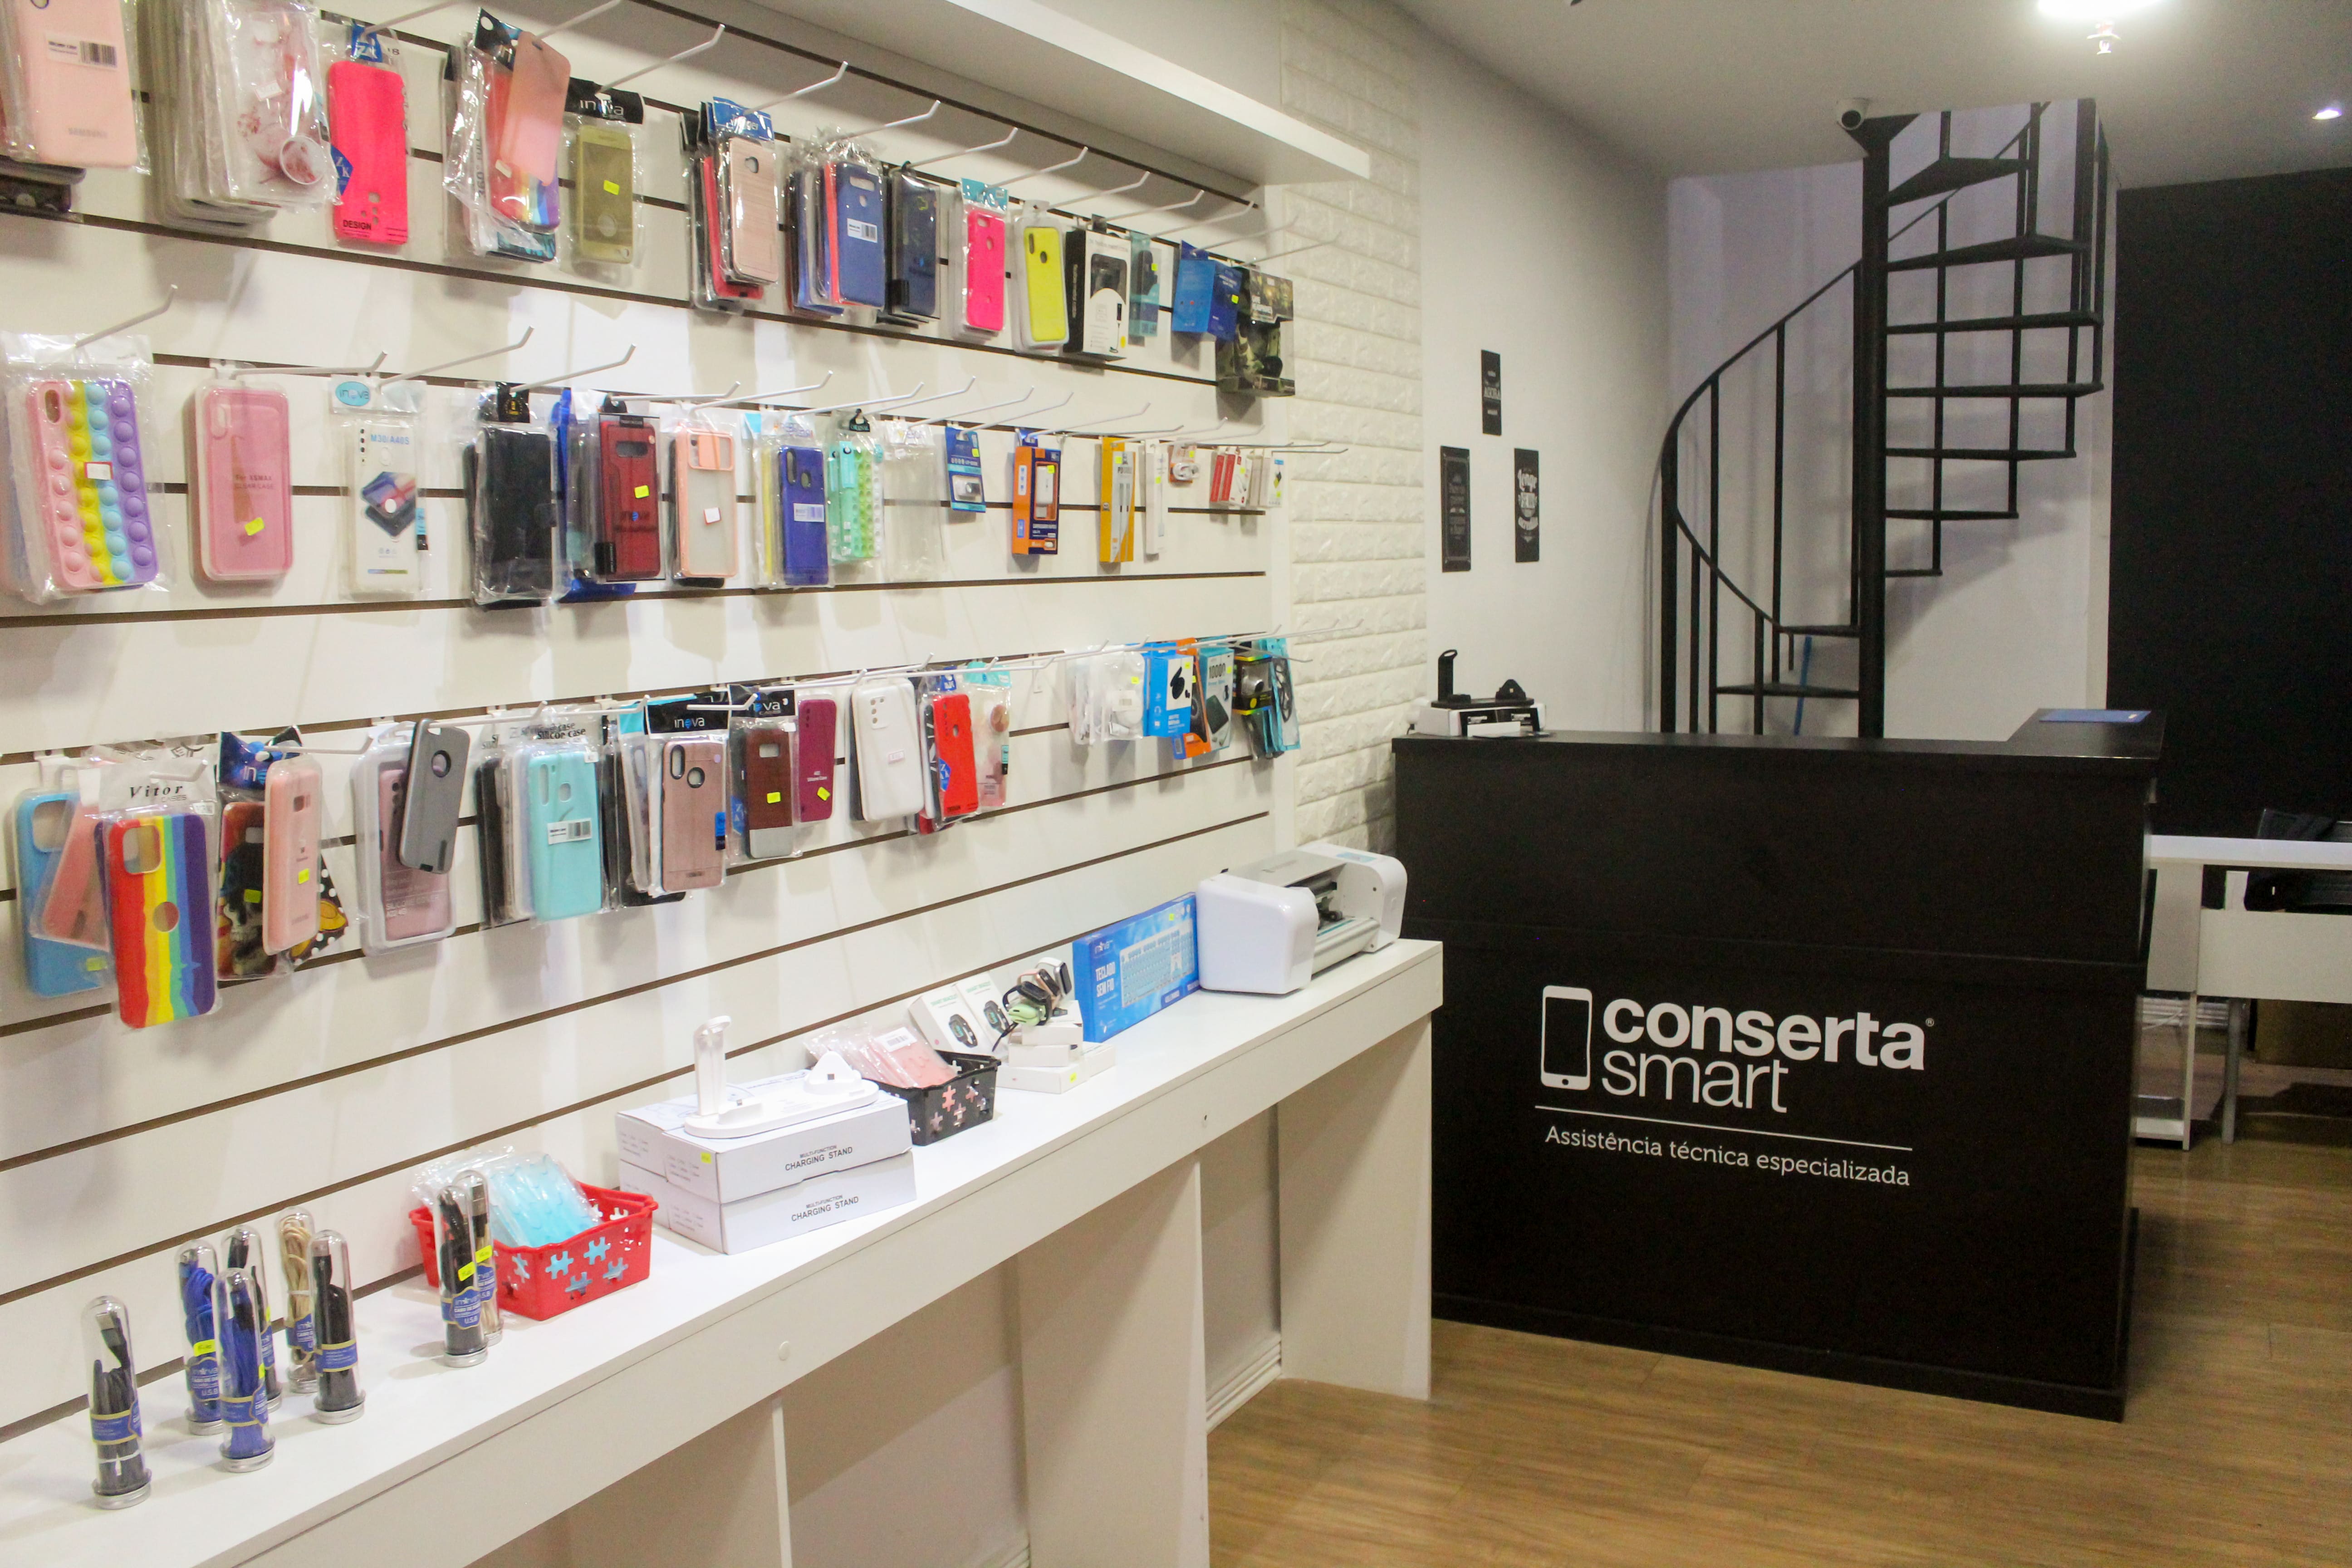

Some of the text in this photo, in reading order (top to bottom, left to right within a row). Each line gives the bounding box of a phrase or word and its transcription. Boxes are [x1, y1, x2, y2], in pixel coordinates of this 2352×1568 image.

[343, 220, 372, 230] DESIGN
[674, 717, 705, 729] inova
[130, 785, 182, 799] Vitor
[1603, 999, 1924, 1070] conserta
[1602, 1050, 1788, 1112] smart
[785, 1147, 853, 1171] CHARGING STAND
[1545, 1126, 1909, 1185] Assistência técnica especializada
[791, 1196, 859, 1221] CHARGING STAND
